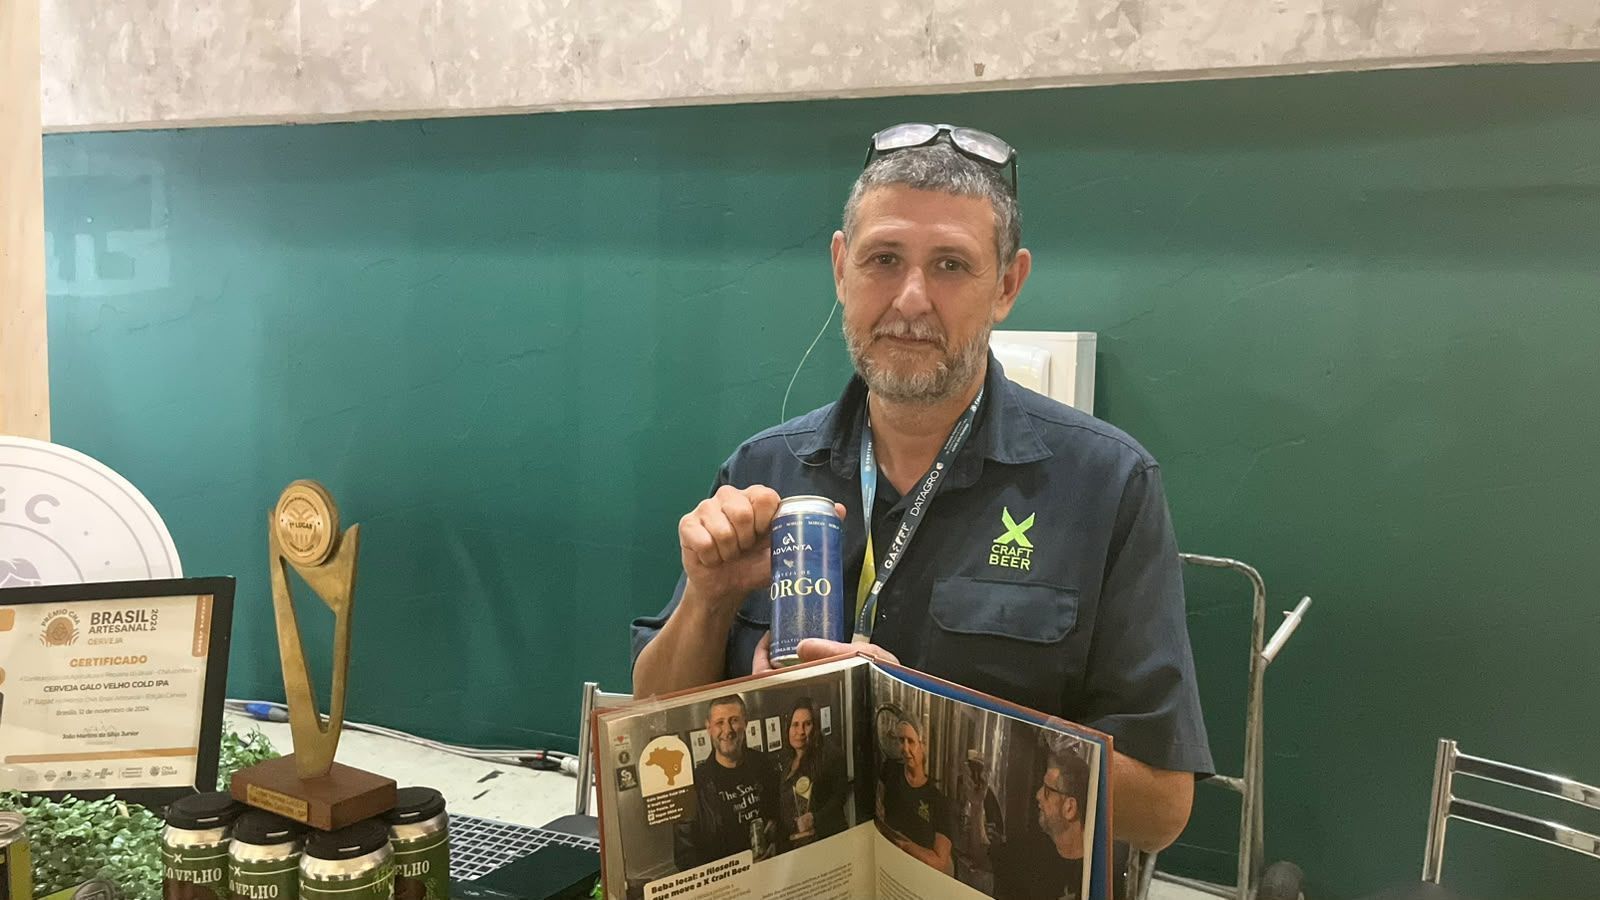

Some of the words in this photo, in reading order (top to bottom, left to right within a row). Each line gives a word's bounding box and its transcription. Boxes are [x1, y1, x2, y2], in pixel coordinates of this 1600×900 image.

[910, 470, 940, 516] DATAGRO
[773, 544, 813, 556] ADVANTA
[991, 544, 1034, 558] CRAFT
[989, 553, 1031, 571] BEER
[90, 609, 149, 625] BRASIL
[150, 608, 159, 632] 2024
[88, 623, 148, 634] ARTESANAL
[88, 637, 123, 646] CERVEJA
[70, 655, 148, 668] CERTIFICADO
[43, 684, 78, 693] CERVEJA
[80, 683, 102, 691] GALO
[104, 682, 130, 690] VELHO
[132, 680, 154, 688] COLD
[175, 868, 222, 884] VELHO
[651, 882, 674, 894] Beba
[675, 873, 698, 886] local:
[706, 859, 740, 876] filosofia
[671, 883, 695, 897] move
[703, 878, 710, 886] X
[711, 870, 731, 882] Craft
[732, 864, 751, 875] Beer
[235, 882, 278, 899] VELHO
